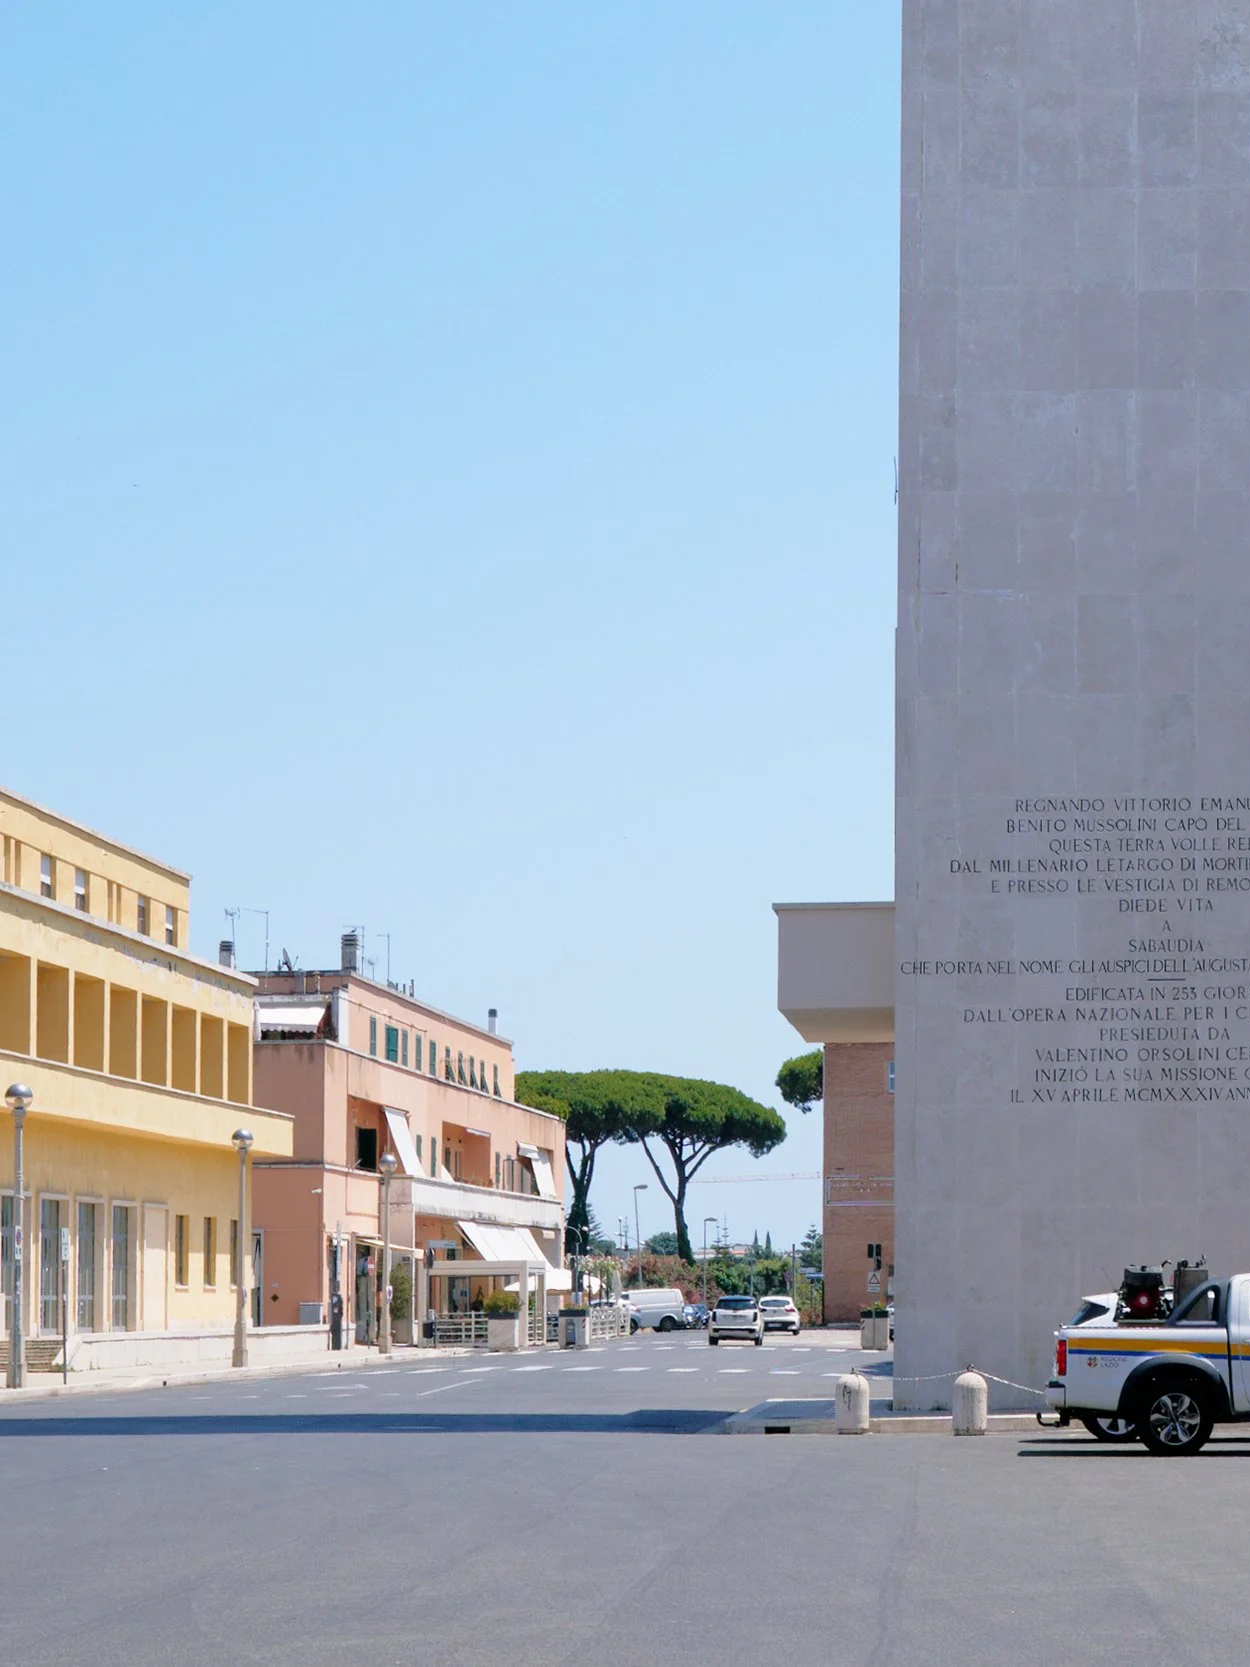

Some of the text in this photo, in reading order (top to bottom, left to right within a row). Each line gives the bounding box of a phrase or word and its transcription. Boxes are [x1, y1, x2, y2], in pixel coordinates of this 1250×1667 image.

[1016, 800, 1104, 812] REGNANDO
[1114, 799, 1191, 811] VITTORIO
[1007, 819, 1067, 833] BENITO
[1074, 819, 1156, 832] MUSSOLINI
[1165, 818, 1207, 831] CAPO
[1217, 818, 1245, 831] DEL
[1049, 839, 1111, 854] QUESTA
[1118, 838, 1164, 851] TERRA
[1171, 838, 1220, 851] VOLLE
[950, 860, 981, 873] DAL
[990, 859, 1088, 872] MILLENARIO
[1096, 858, 1173, 871] LETARGO
[1181, 858, 1196, 871] DI
[992, 880, 1000, 893] E
[1008, 879, 1069, 893] PRESSO
[1077, 879, 1095, 892] LE
[1105, 878, 1175, 892] VESTIGIA
[1183, 878, 1198, 891] DI
[1119, 899, 1214, 912] DIEDE VITA
[1162, 920, 1171, 932] A
[1129, 939, 1204, 952] SABAUDIA
[901, 961, 931, 975] CHE
[935, 961, 983, 975] PORTA
[987, 961, 1016, 974] NEL
[1020, 960, 1062, 974] NOME
[1069, 960, 1094, 974] GLI
[1099, 960, 1150, 973] AUSPICI
[1066, 988, 1145, 1001] EDIFICATA
[1151, 987, 1165, 1000] IN
[1172, 987, 1197, 1000] 253
[1076, 1008, 1175, 1021] NAZIONALE
[1184, 1007, 1214, 1020] PER
[1100, 1027, 1230, 1041] PRESIEDUTA DA
[1036, 1049, 1128, 1062] VALENTINO
[1138, 1048, 1219, 1061] ORSOLINI
[1095, 1069, 1115, 1081] LA
[1124, 1068, 1153, 1081] SUA
[1161, 1068, 1237, 1081] MISSIONE
[1011, 1089, 1023, 1103] IL
[1032, 1089, 1056, 1102] XV
[1062, 1088, 1119, 1102] APRILE
[1124, 1087, 1223, 1101] MCMXXXIV
